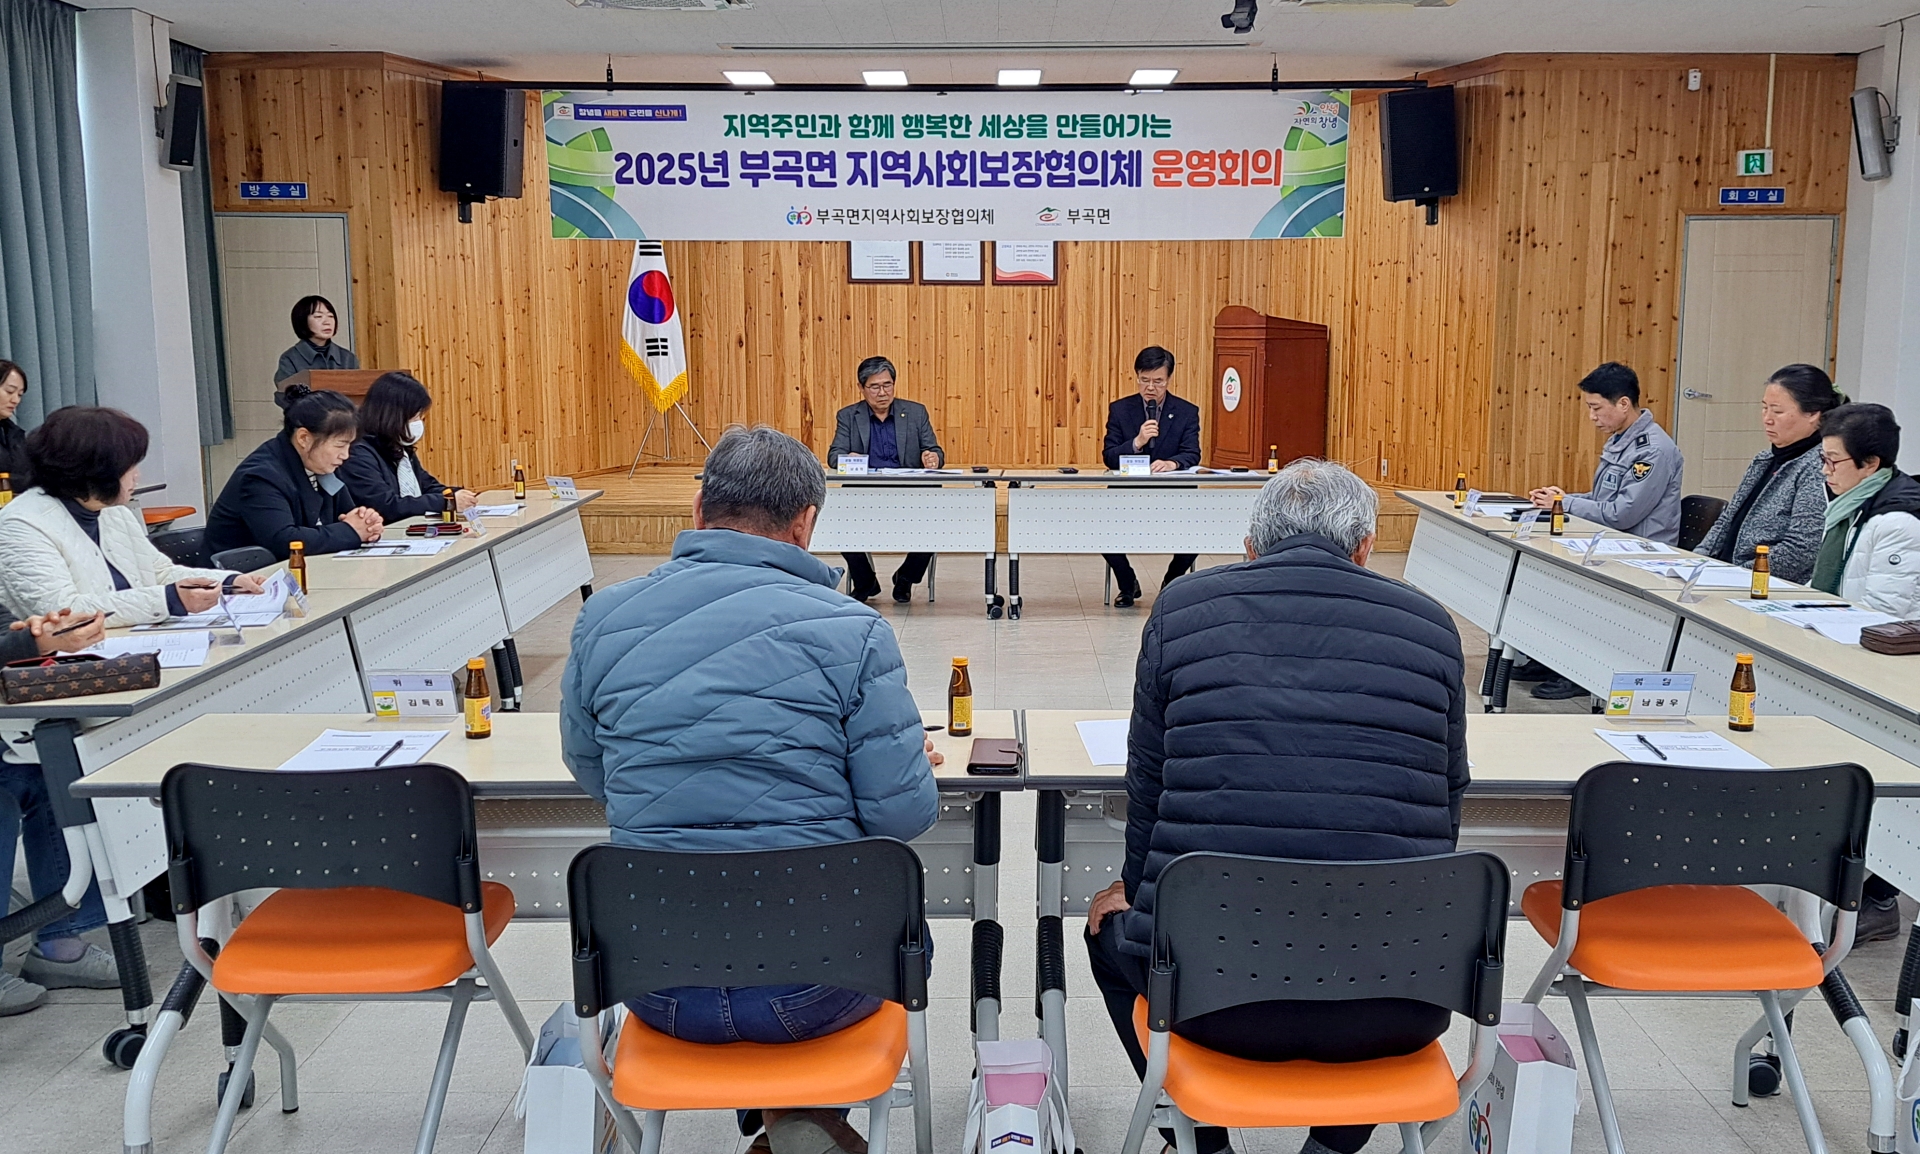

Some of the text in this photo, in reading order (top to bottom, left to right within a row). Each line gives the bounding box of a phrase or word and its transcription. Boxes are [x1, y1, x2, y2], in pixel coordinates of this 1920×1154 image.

[723, 113, 1172, 139] 지역주민과 함께 행복한 세상을 만들어가는
[1319, 116, 1338, 129] 창녕
[613, 149, 1283, 188] 2025년 부곡면 지역사회보장협의체 운영회의
[816, 208, 995, 226] 부곡면지역사회보장협의체
[1067, 208, 1110, 225] 부곡면
